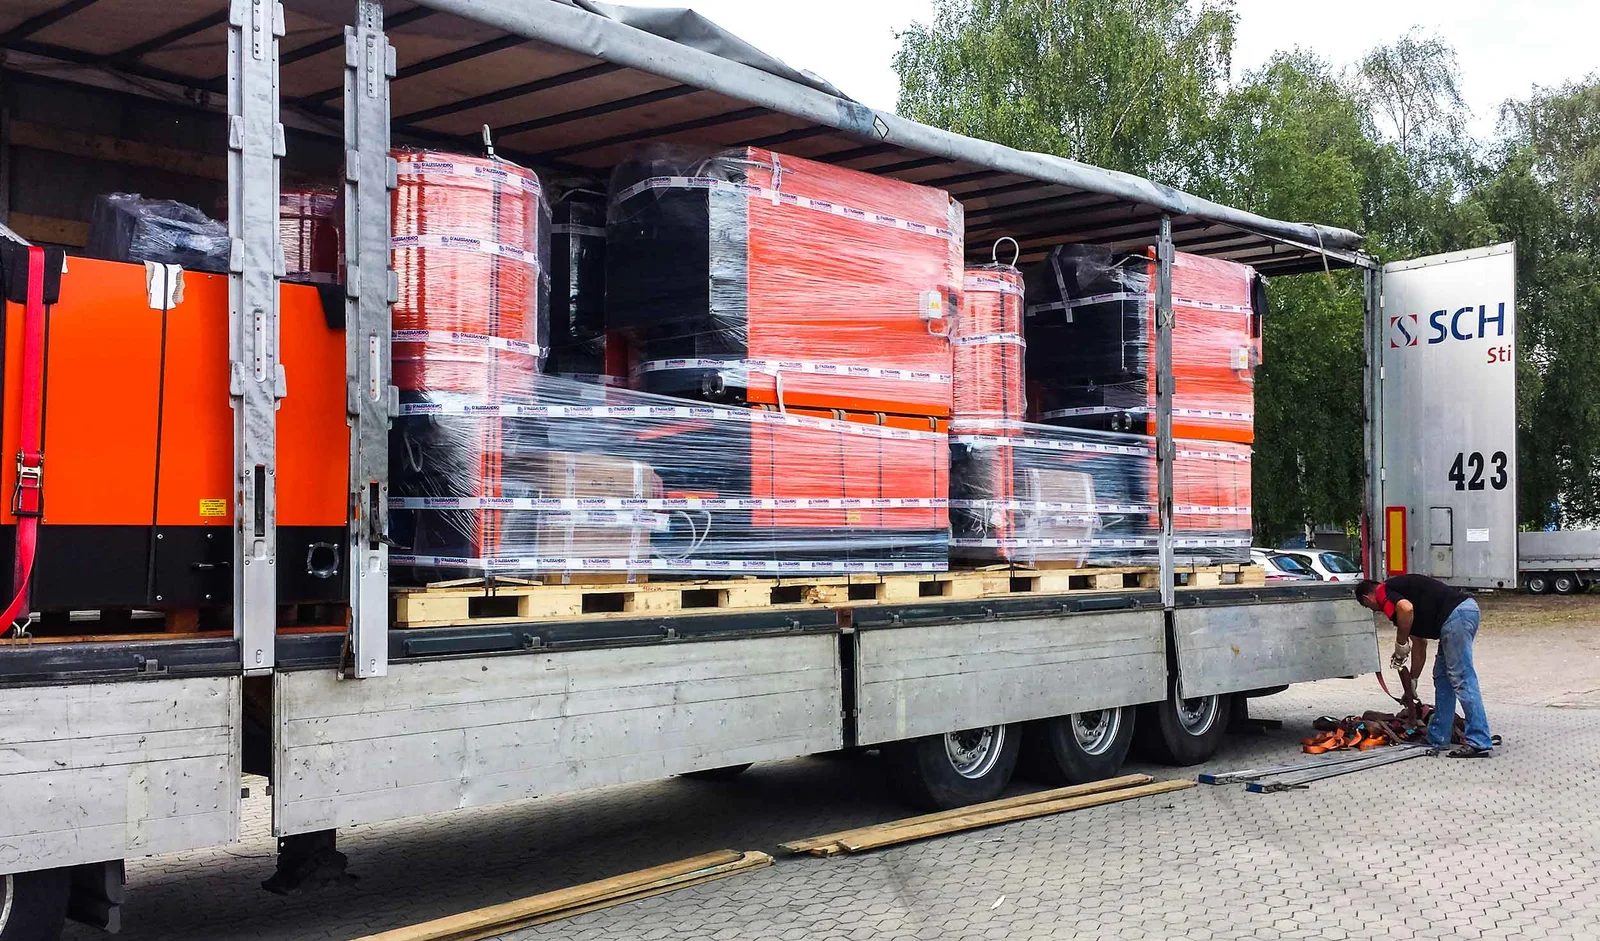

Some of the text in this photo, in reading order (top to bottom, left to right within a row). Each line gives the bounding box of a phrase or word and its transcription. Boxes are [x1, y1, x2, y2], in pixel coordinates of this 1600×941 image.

[1428, 302, 1505, 344] SCH
[1487, 345, 1511, 363] Sti
[1448, 451, 1508, 491] 423
